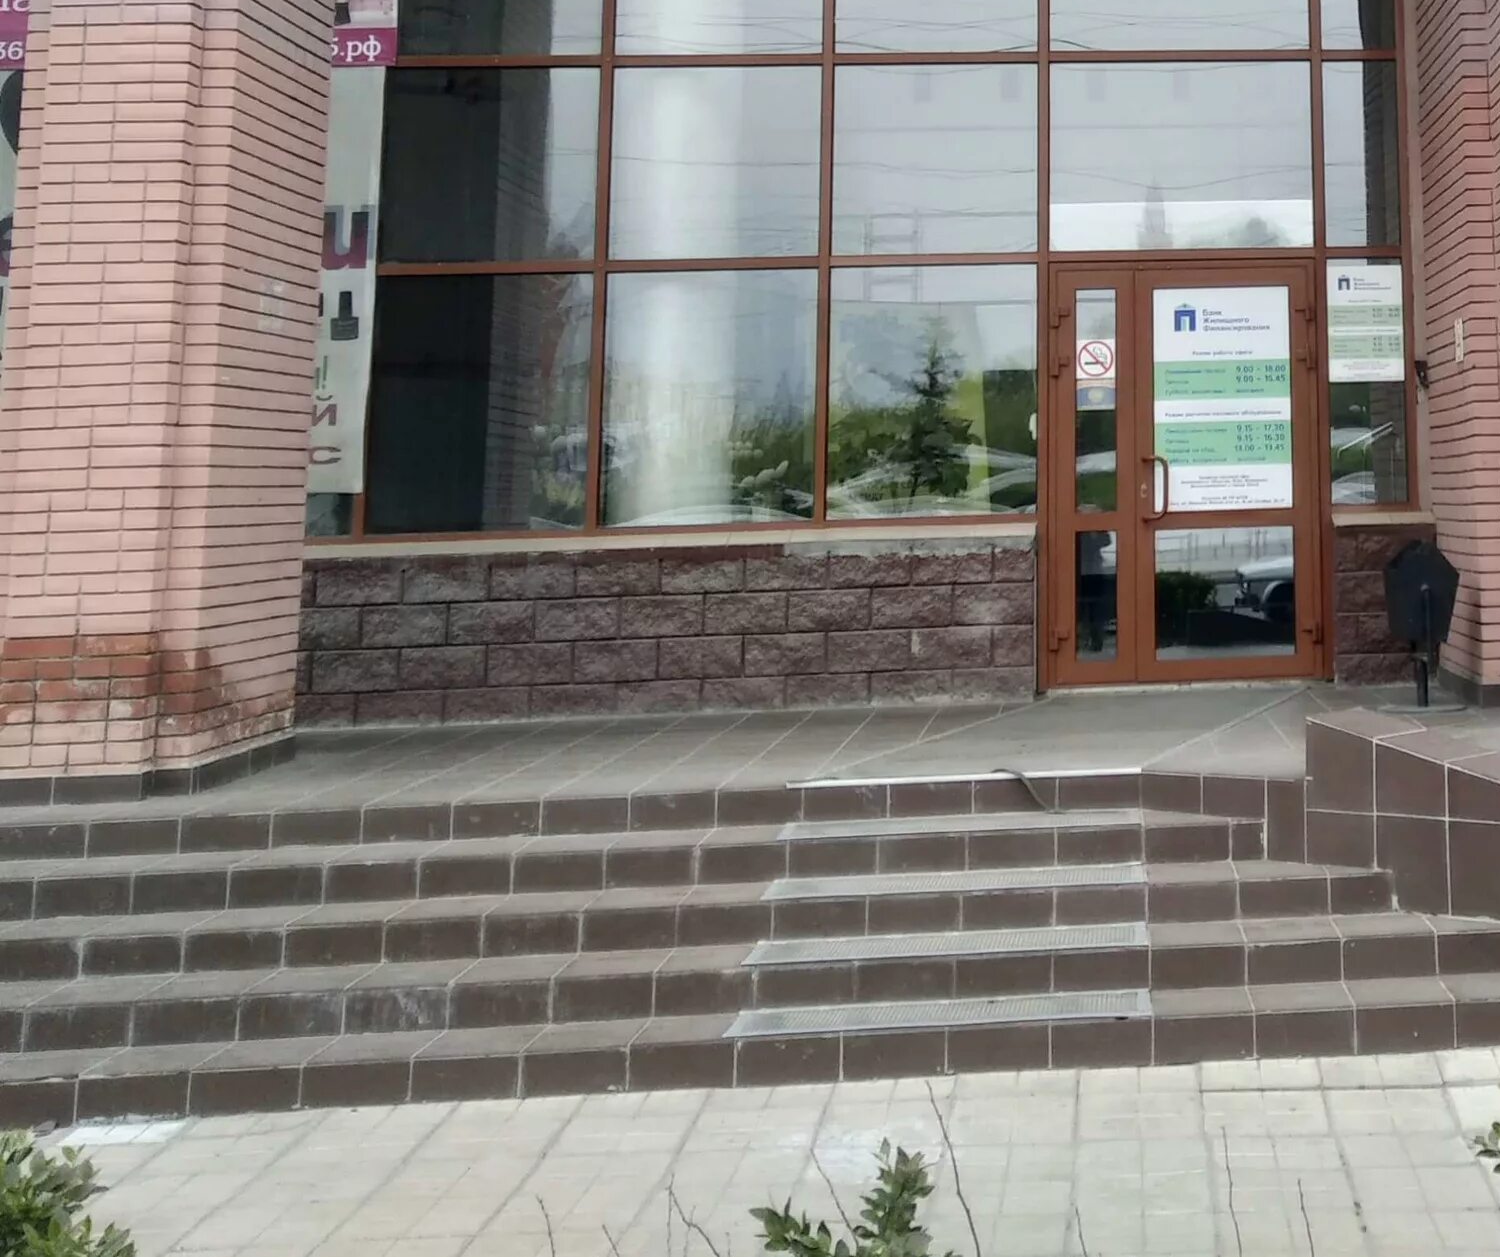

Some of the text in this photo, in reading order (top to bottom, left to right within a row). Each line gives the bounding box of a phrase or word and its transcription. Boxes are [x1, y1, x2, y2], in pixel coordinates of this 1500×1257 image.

[1202, 308, 1222, 316] Банк
[1236, 365, 1254, 373] 9.00
[1236, 375, 1254, 383] 9.00
